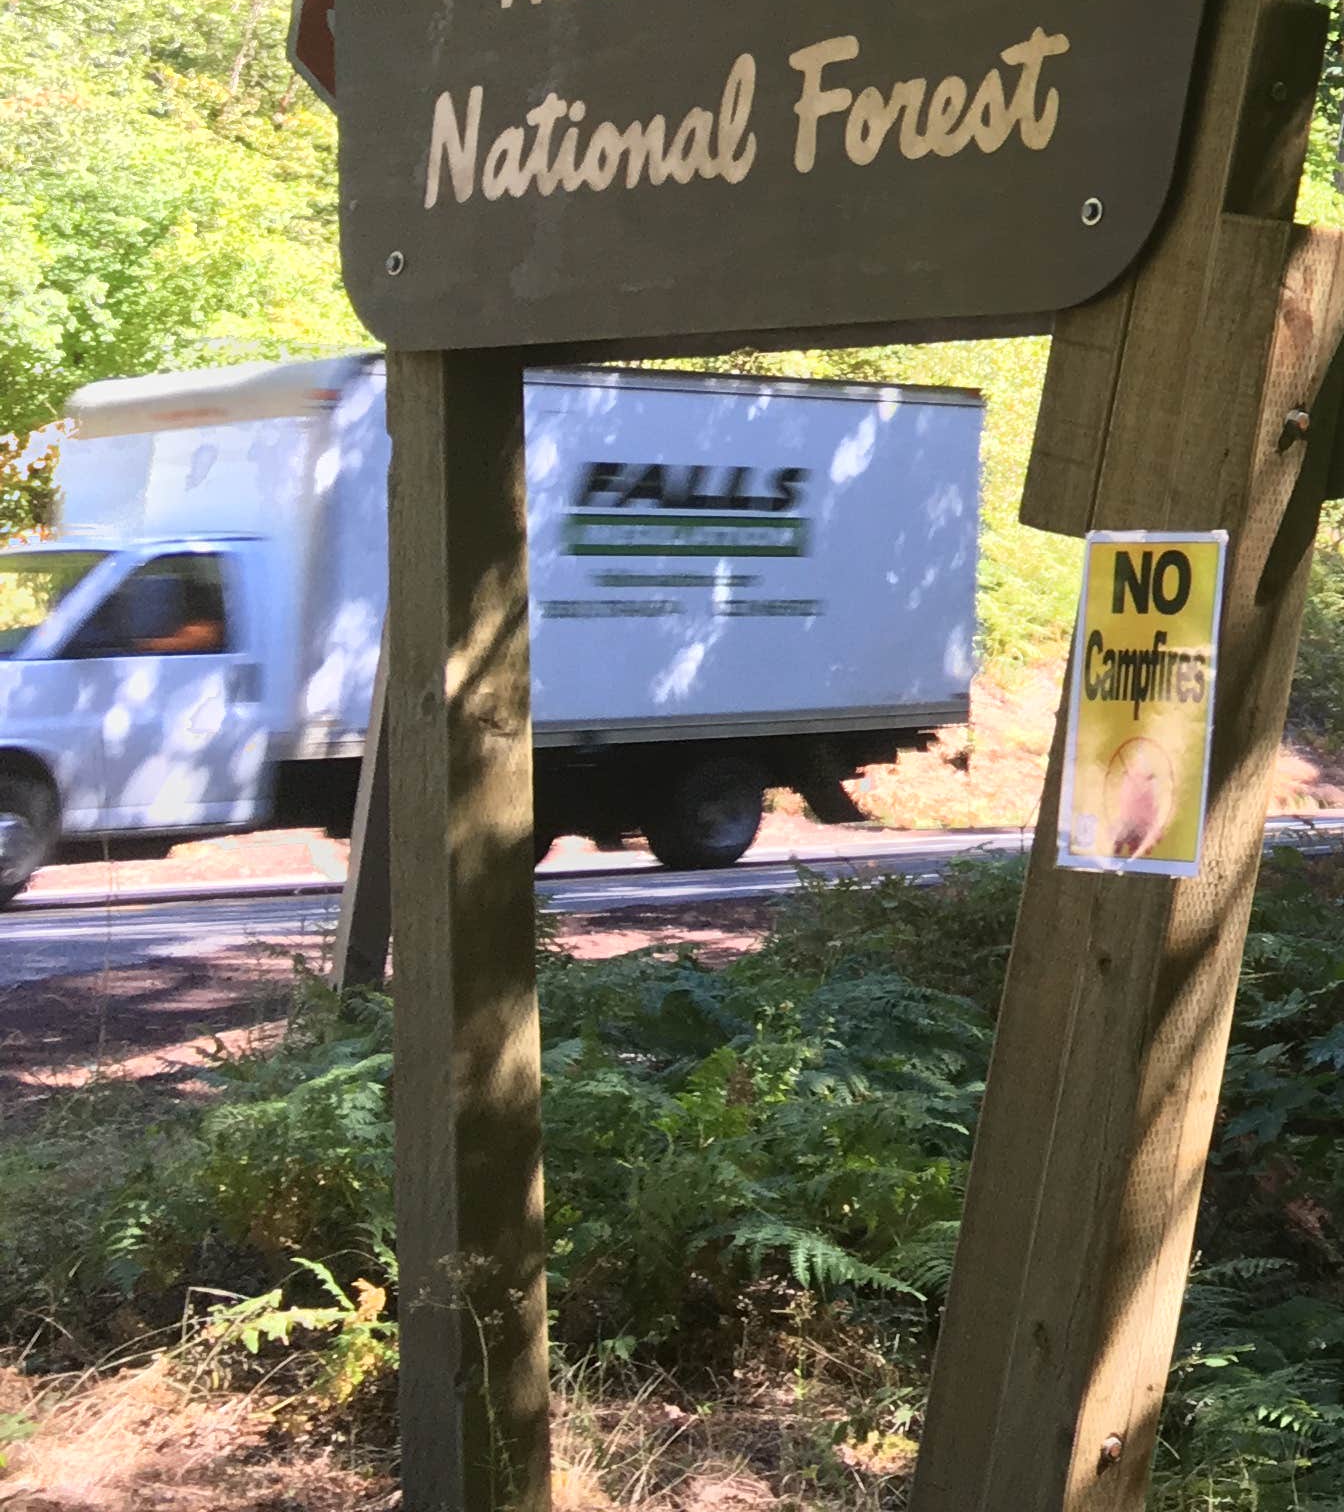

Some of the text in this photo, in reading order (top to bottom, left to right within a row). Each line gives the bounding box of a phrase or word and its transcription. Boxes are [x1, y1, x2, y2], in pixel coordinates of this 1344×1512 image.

[423, 26, 1069, 209] National Forest
[1112, 550, 1191, 615] NO
[1084, 630, 1205, 720] Campfires
